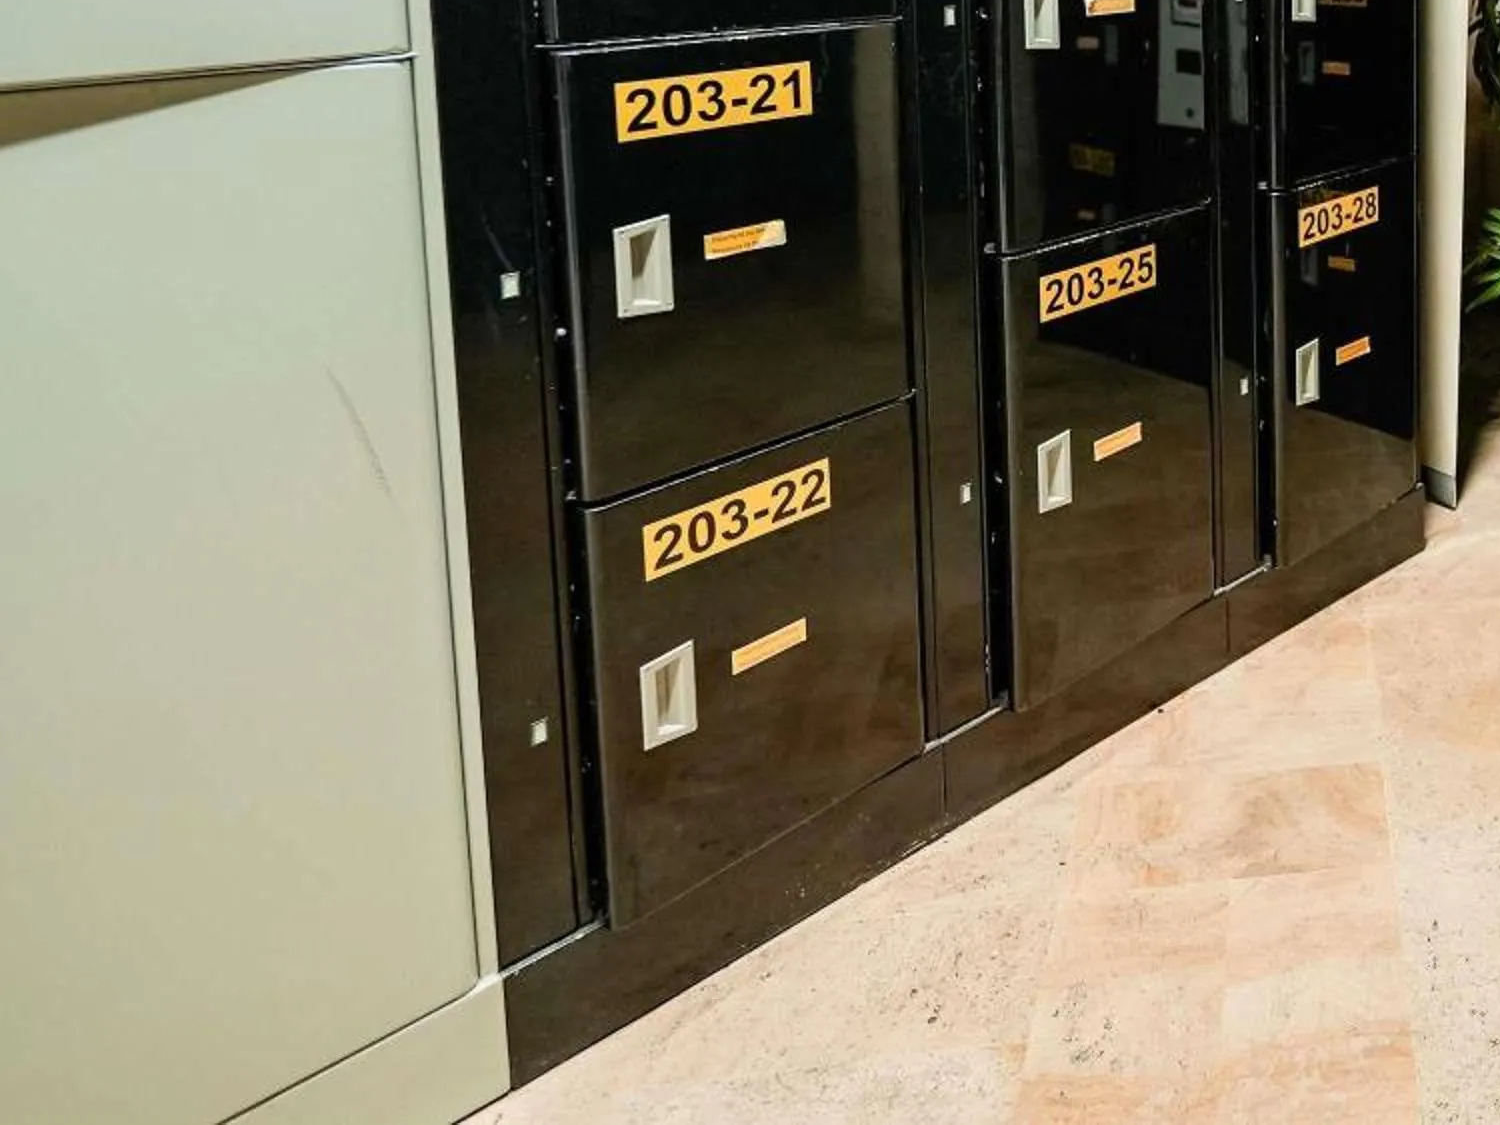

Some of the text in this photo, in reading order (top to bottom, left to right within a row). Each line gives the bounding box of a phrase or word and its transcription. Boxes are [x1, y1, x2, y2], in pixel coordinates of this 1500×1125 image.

[626, 69, 801, 133] 203-21
[1303, 192, 1375, 241] 203-28
[1045, 250, 1154, 315] 203-25
[653, 468, 827, 570] 203-22
